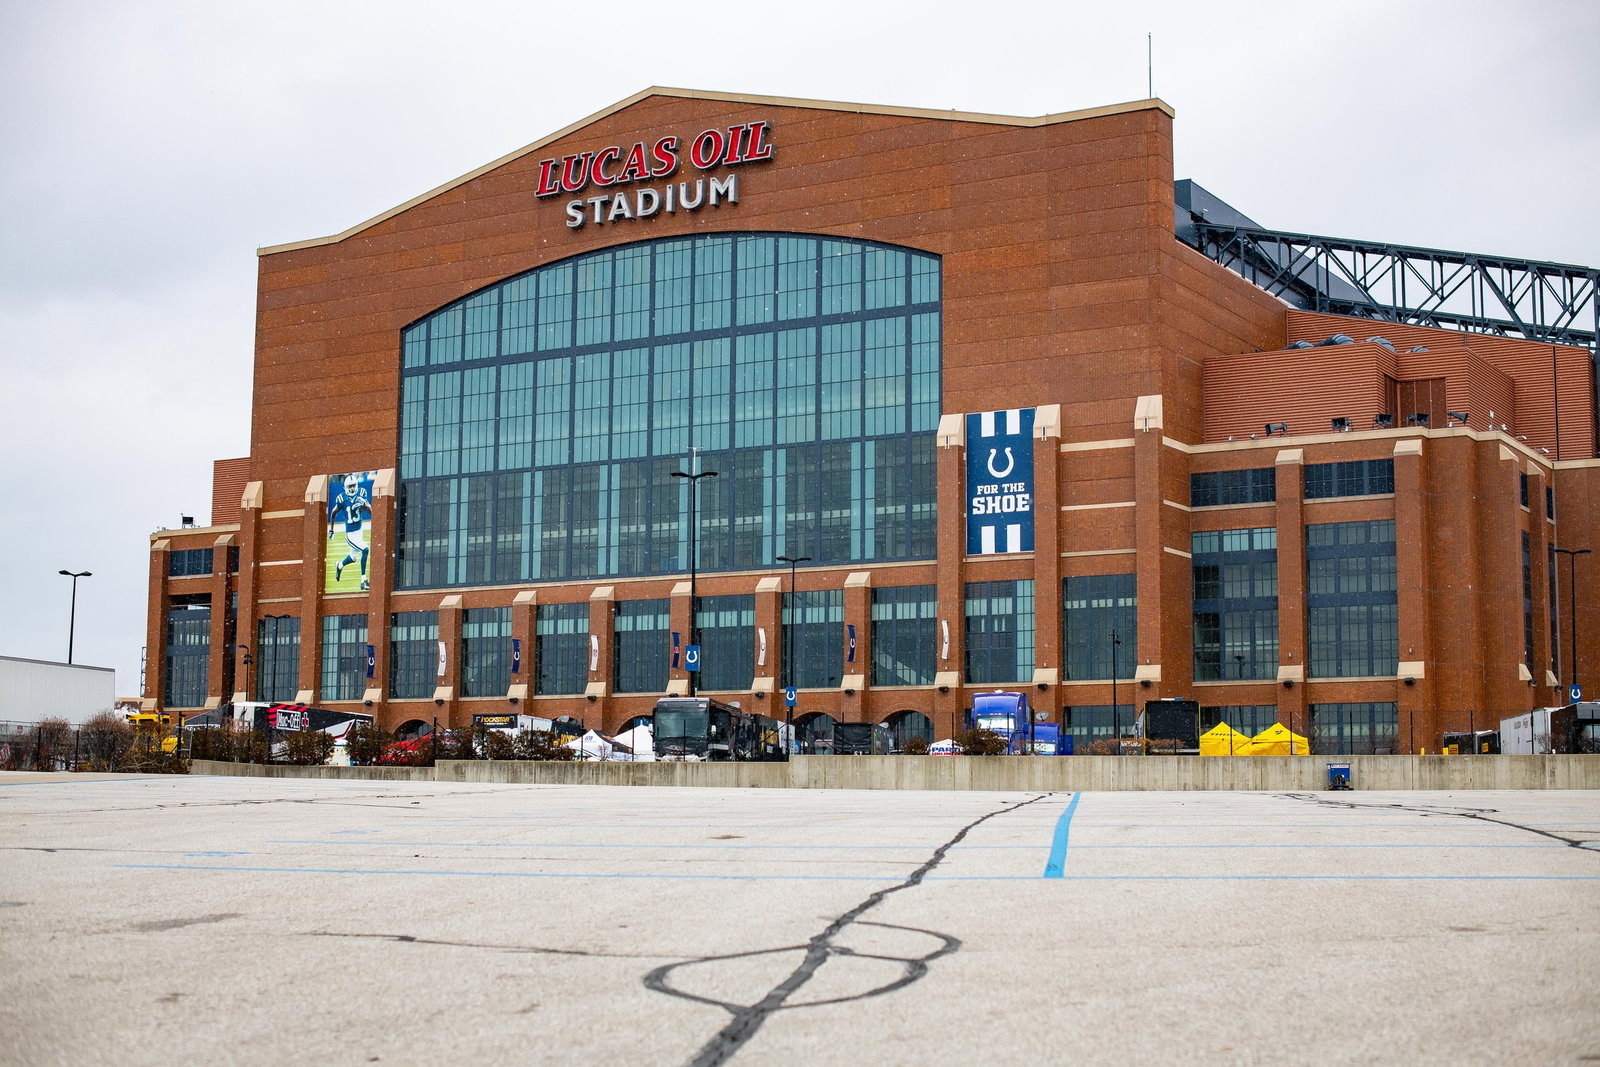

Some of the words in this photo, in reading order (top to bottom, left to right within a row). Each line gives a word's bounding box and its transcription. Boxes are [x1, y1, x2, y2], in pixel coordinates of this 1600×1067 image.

[535, 136, 681, 198] LUCAS
[690, 120, 775, 170] OIL
[566, 173, 739, 228] STADIUM
[976, 484, 999, 495] FOR
[1002, 482, 1025, 493] THE
[346, 505, 360, 523] 13
[972, 493, 1030, 515] SHOE
